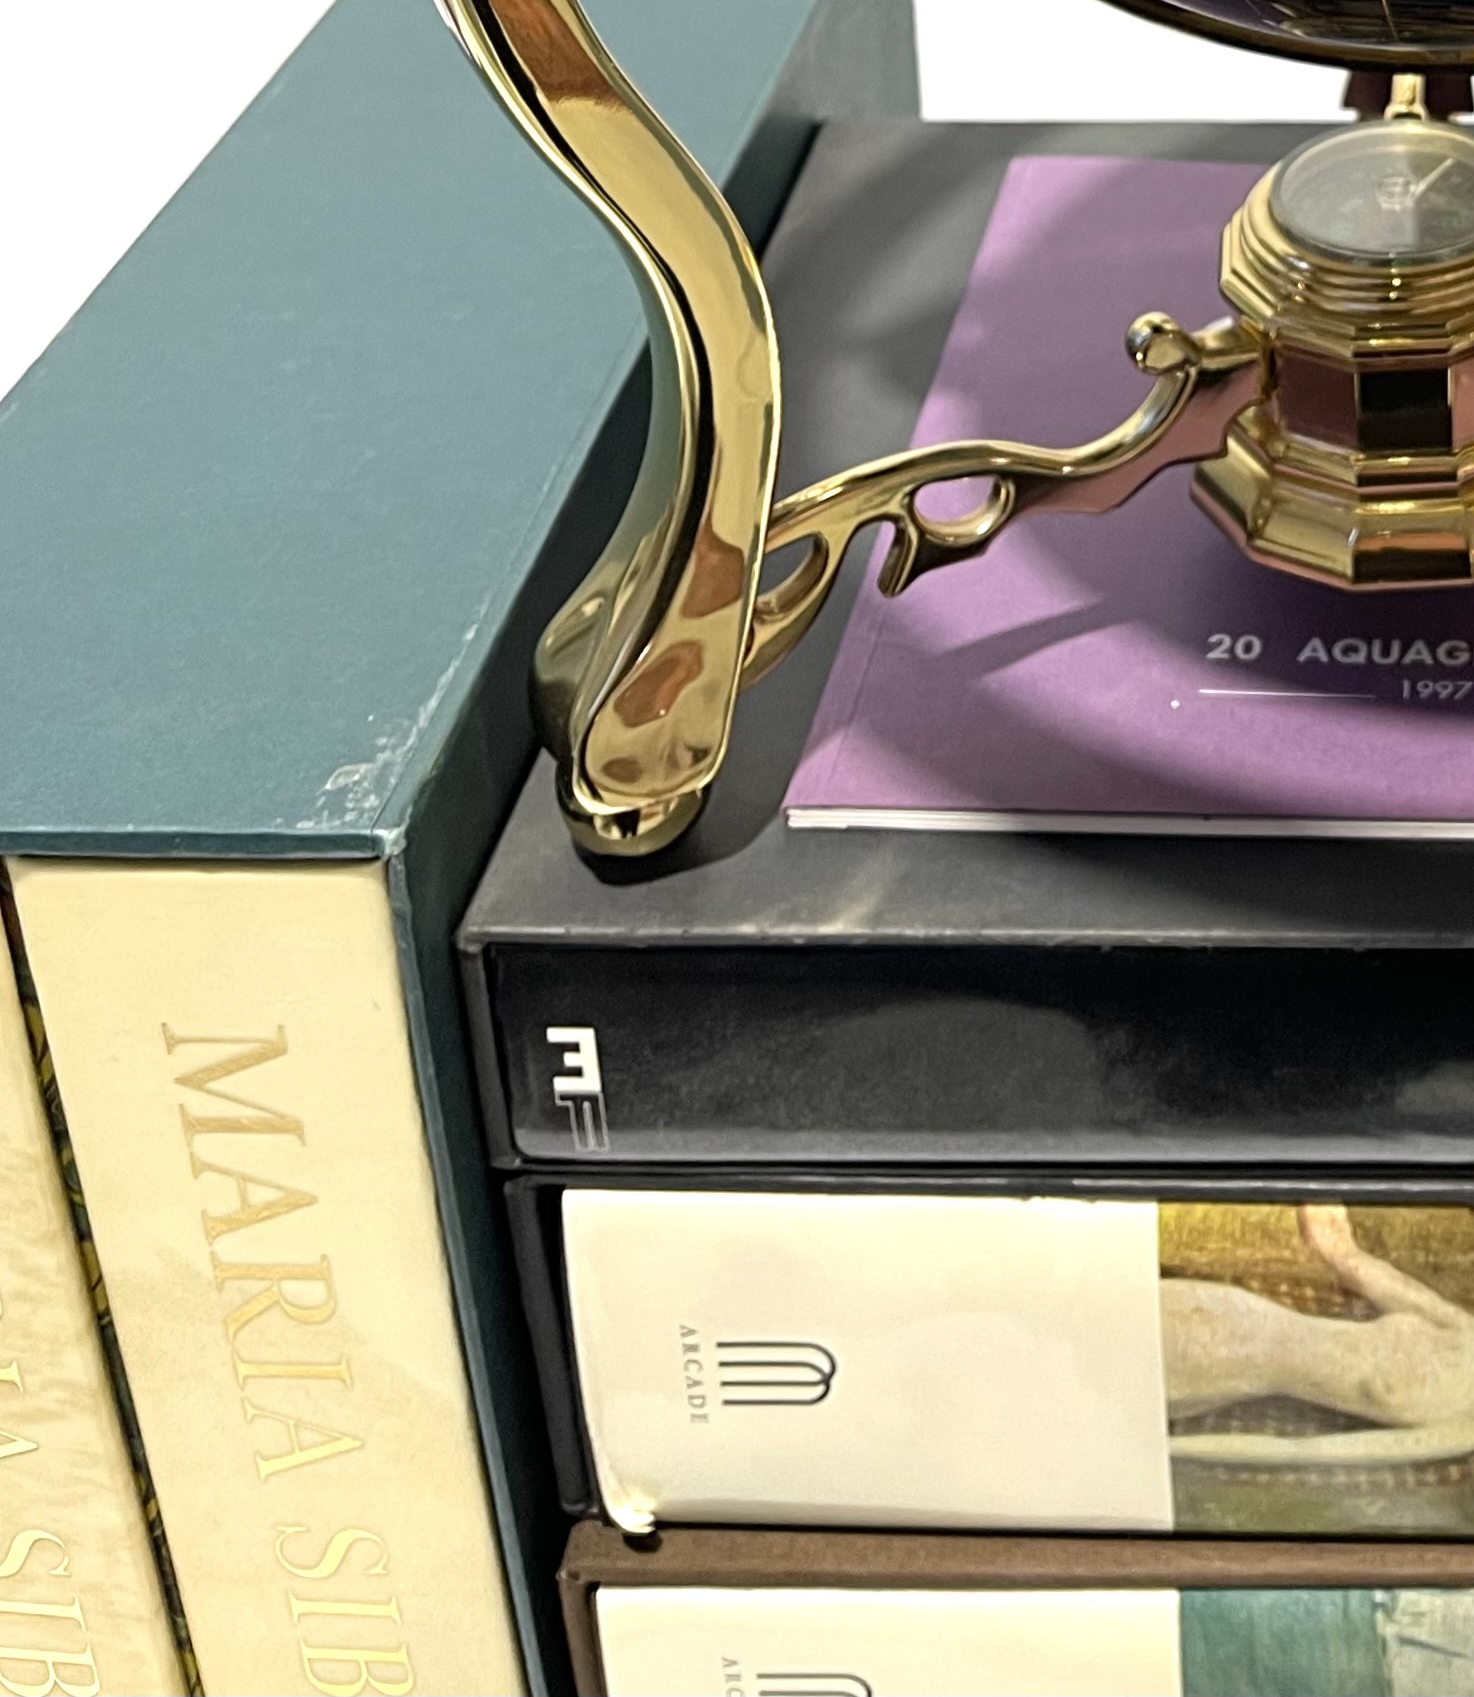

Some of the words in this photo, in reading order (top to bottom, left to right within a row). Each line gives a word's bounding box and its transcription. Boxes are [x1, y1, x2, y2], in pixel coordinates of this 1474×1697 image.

[1205, 635, 1263, 661] 20
[1401, 679, 1474, 701] 1997
[160, 1021, 365, 1481] MARIA
[677, 1321, 712, 1427] ARCADE
